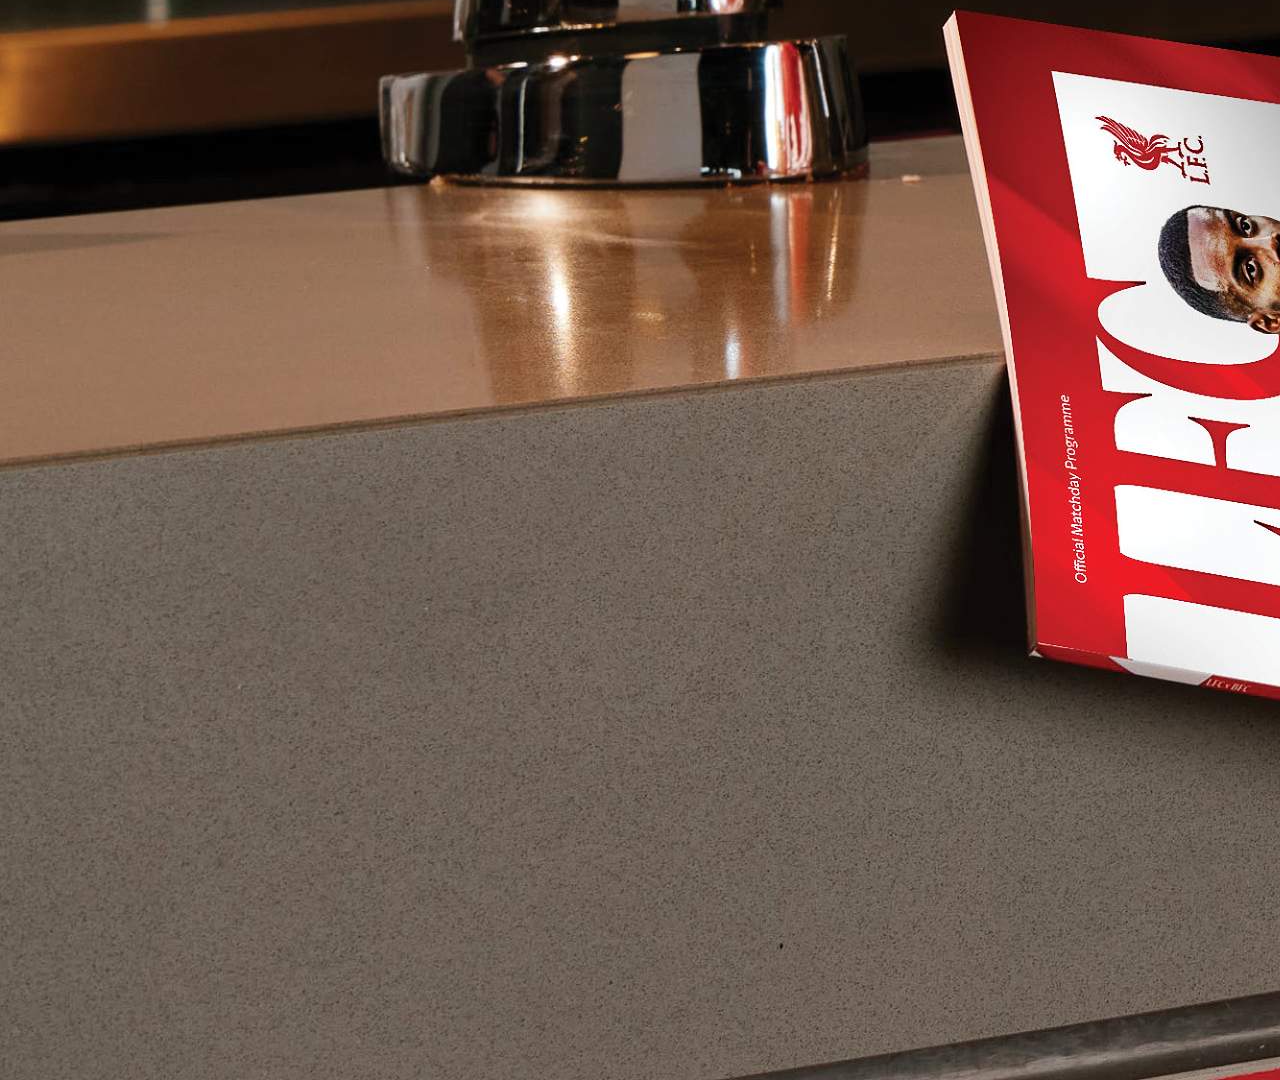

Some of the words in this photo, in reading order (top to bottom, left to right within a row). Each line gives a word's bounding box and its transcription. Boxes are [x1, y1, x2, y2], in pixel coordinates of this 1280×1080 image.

[1183, 135, 1212, 185] L.F.C.
[1060, 394, 1079, 470] Programme
[1067, 472, 1083, 537] Matchday
[1071, 537, 1088, 584] Official
